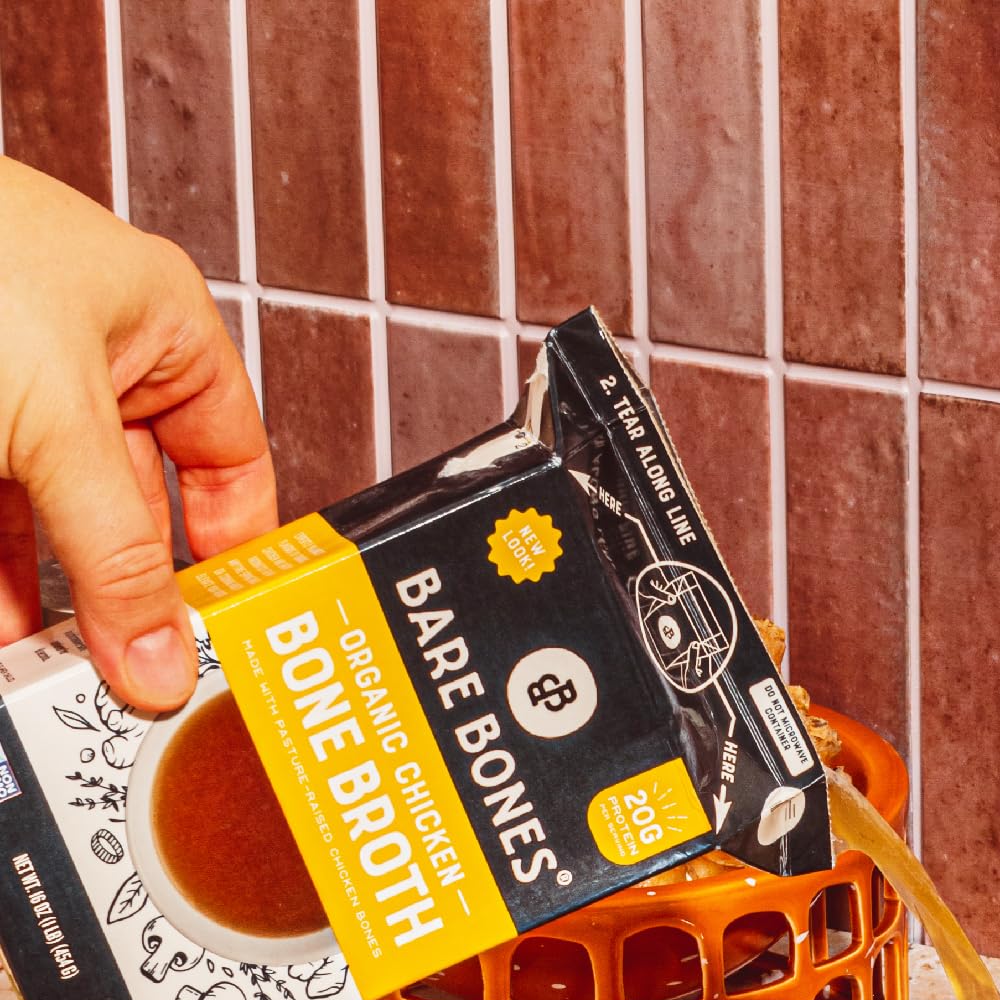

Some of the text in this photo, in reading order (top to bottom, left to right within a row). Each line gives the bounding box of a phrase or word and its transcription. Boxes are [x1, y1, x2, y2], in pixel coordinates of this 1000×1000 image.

[600, 374, 697, 546] 2. TEAR ALONG LINE
[599, 485, 622, 517] HERE
[501, 530, 536, 572] LOOK!
[518, 524, 547, 556] NEW
[395, 567, 486, 710] BARE
[764, 684, 809, 765] DO NOT MICROWAVE
[764, 707, 791, 752] CONTAINER
[265, 610, 444, 948] BONE BROTH
[339, 627, 465, 887] ORGANIC CHICKEN
[720, 740, 739, 784] HERE
[242, 639, 383, 959] MADE WITH PASTURE-RAISED CHICKEN BONES
[623, 789, 664, 845] 20G
[608, 795, 639, 857] PROTEIN
[12, 853, 35, 875] NET
[21, 871, 42, 893] WT.
[28, 890, 47, 904] 16
[33, 902, 54, 919] OZ
